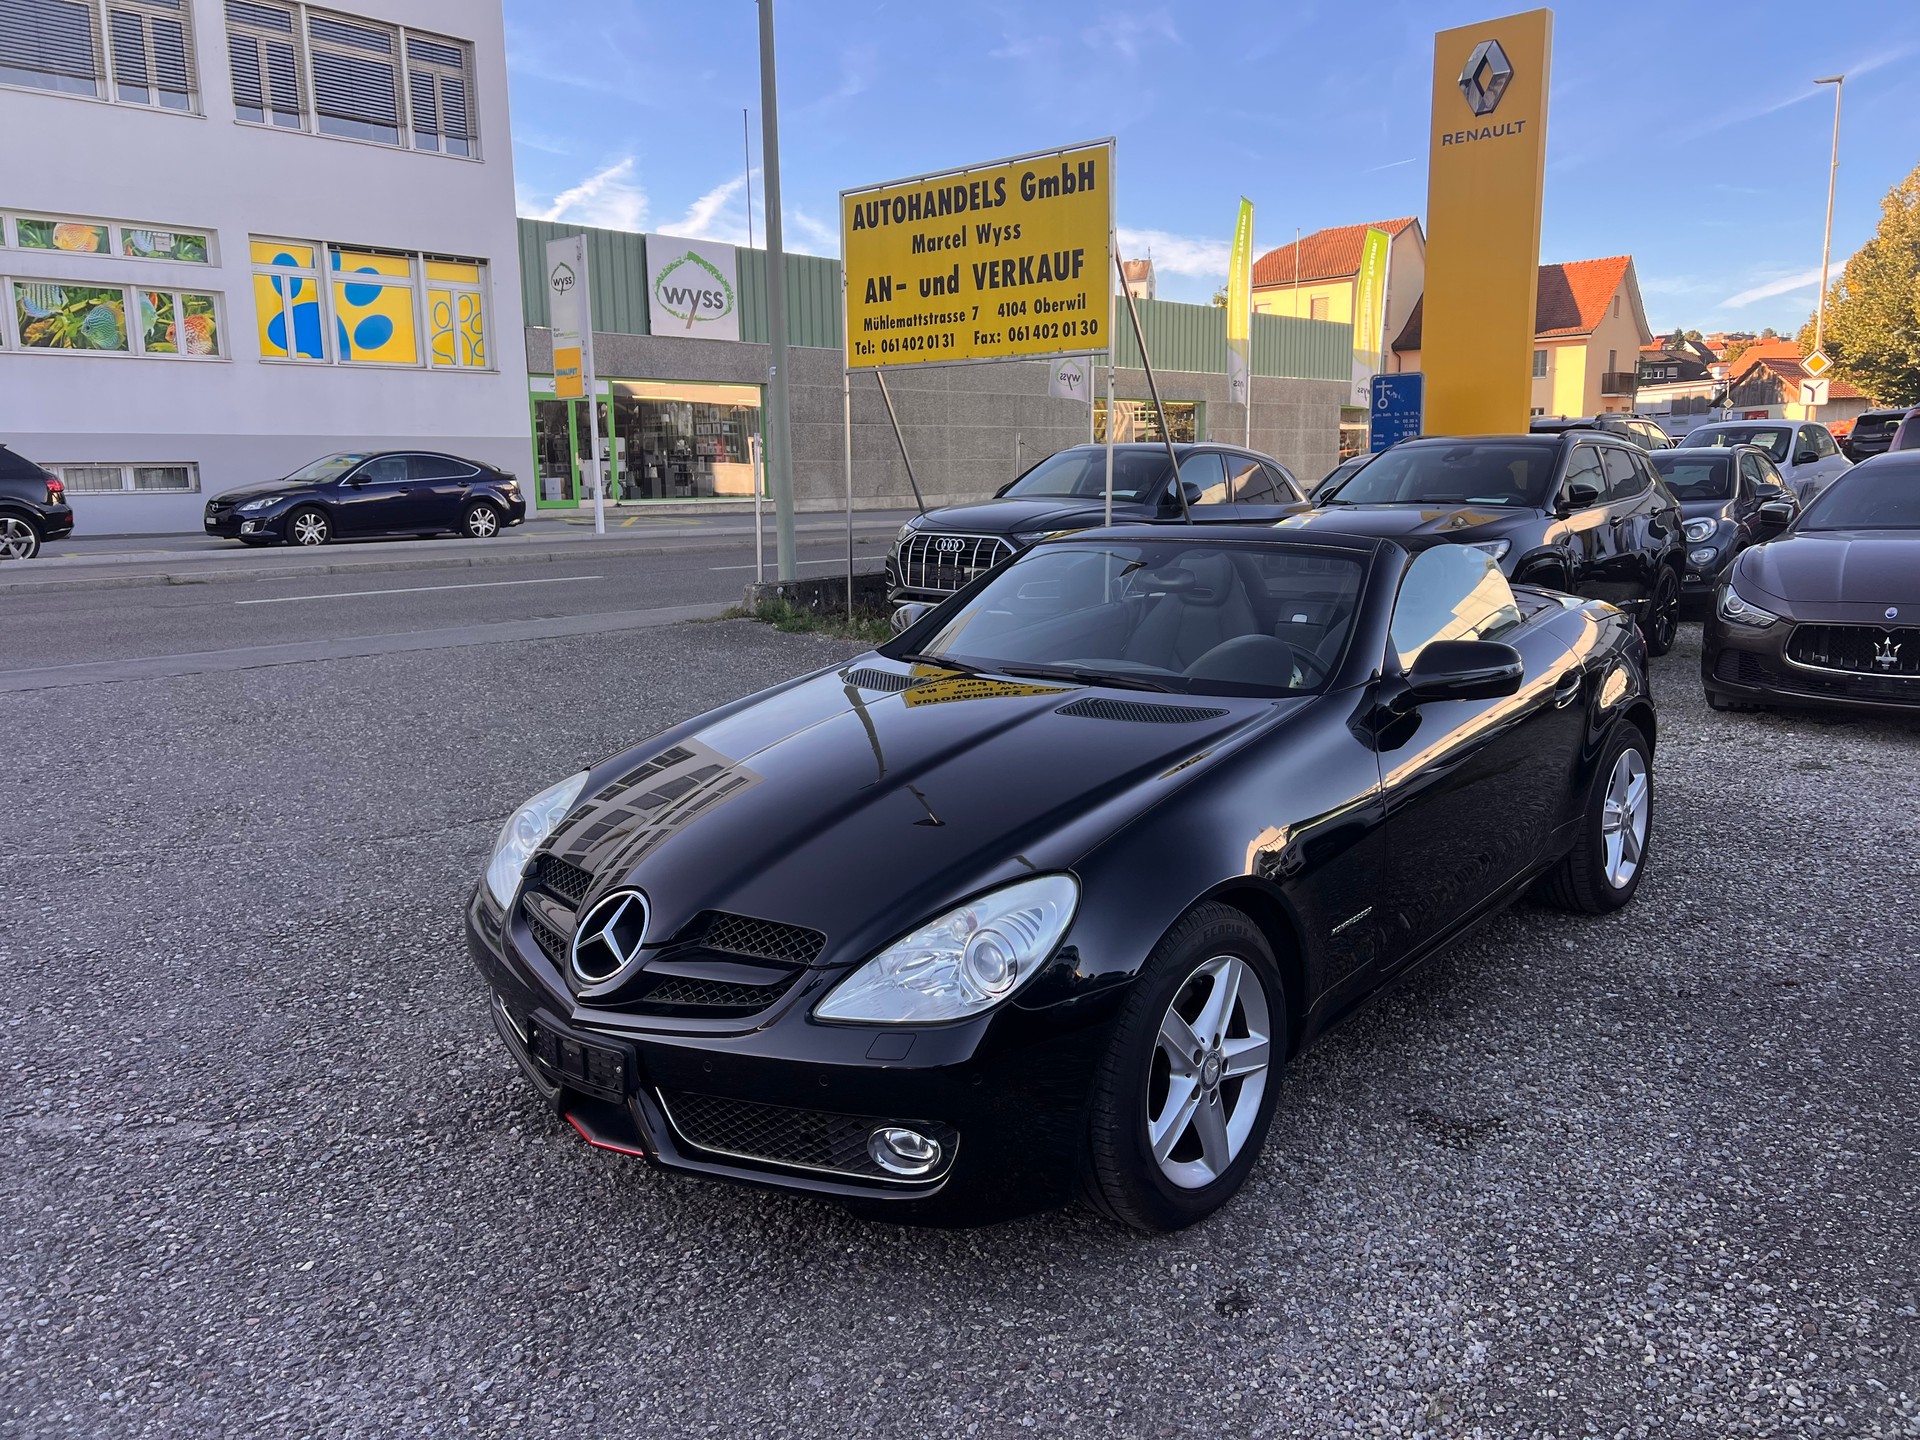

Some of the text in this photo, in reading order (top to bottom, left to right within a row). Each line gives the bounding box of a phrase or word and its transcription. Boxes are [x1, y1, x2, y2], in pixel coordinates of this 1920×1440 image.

[1442, 120, 1526, 146] RENAULT
[853, 160, 1095, 230] AUTOHANDELS GmbH
[912, 223, 1021, 254] Marcel Wyss
[919, 264, 960, 298] und
[972, 249, 1084, 291] VERKAUF
[863, 293, 1086, 332] Mühlemattstrasse 7 4104 Oberwil
[855, 341, 875, 355] Tel:
[974, 330, 1001, 345] Fax:
